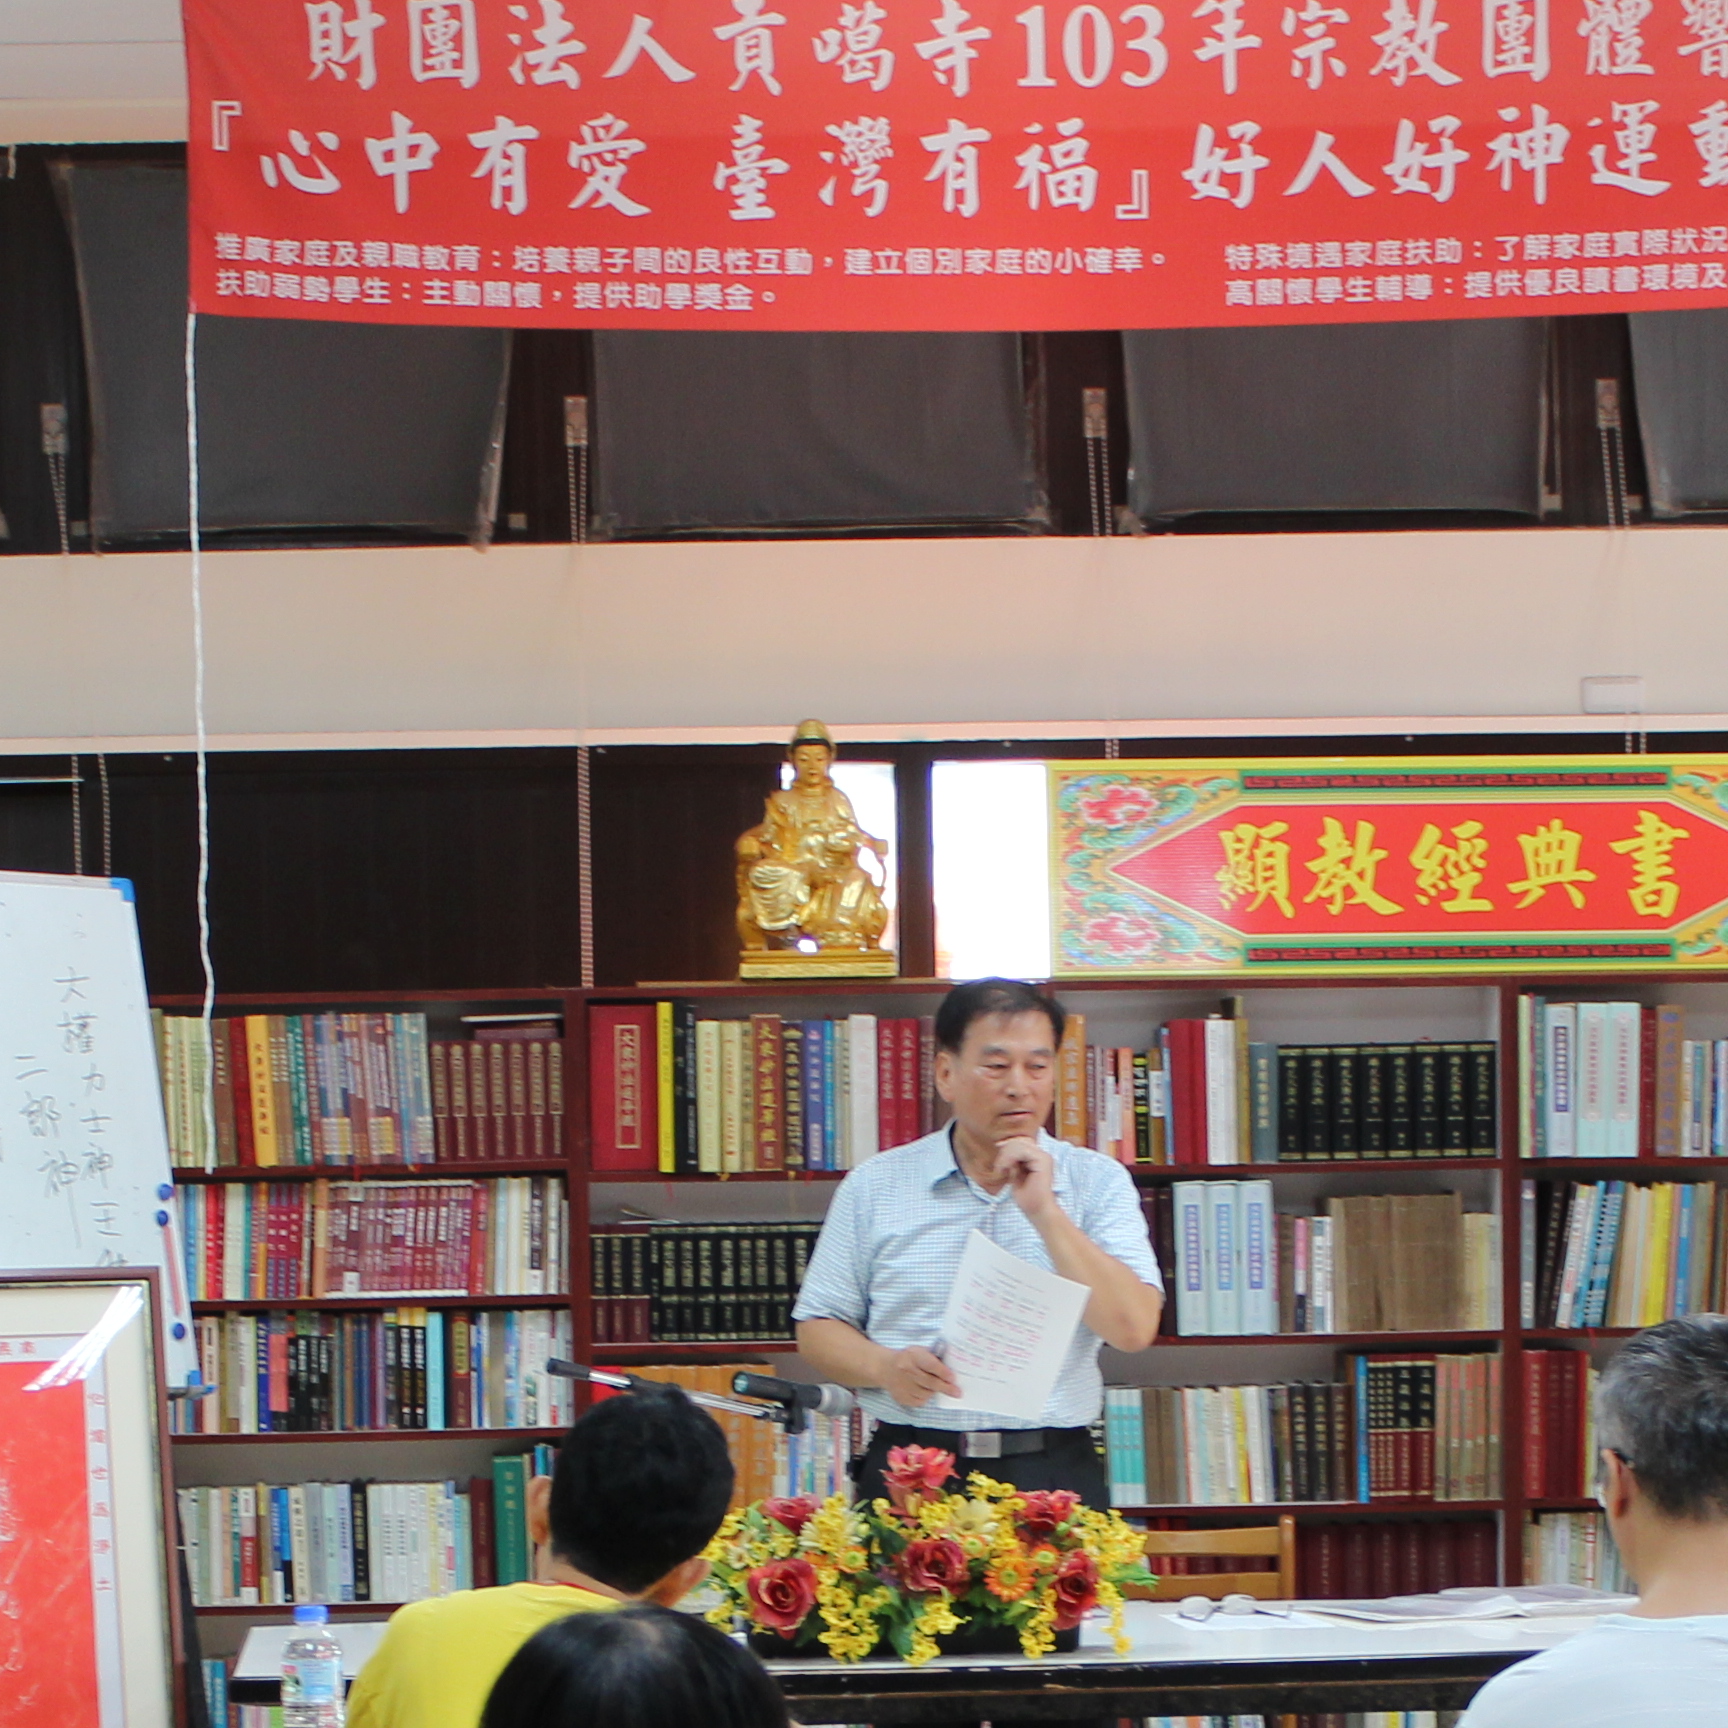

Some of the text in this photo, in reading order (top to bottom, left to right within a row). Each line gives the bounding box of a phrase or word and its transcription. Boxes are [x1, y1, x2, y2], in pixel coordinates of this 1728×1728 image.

[1215, 809, 1693, 920] 顯教經典書
